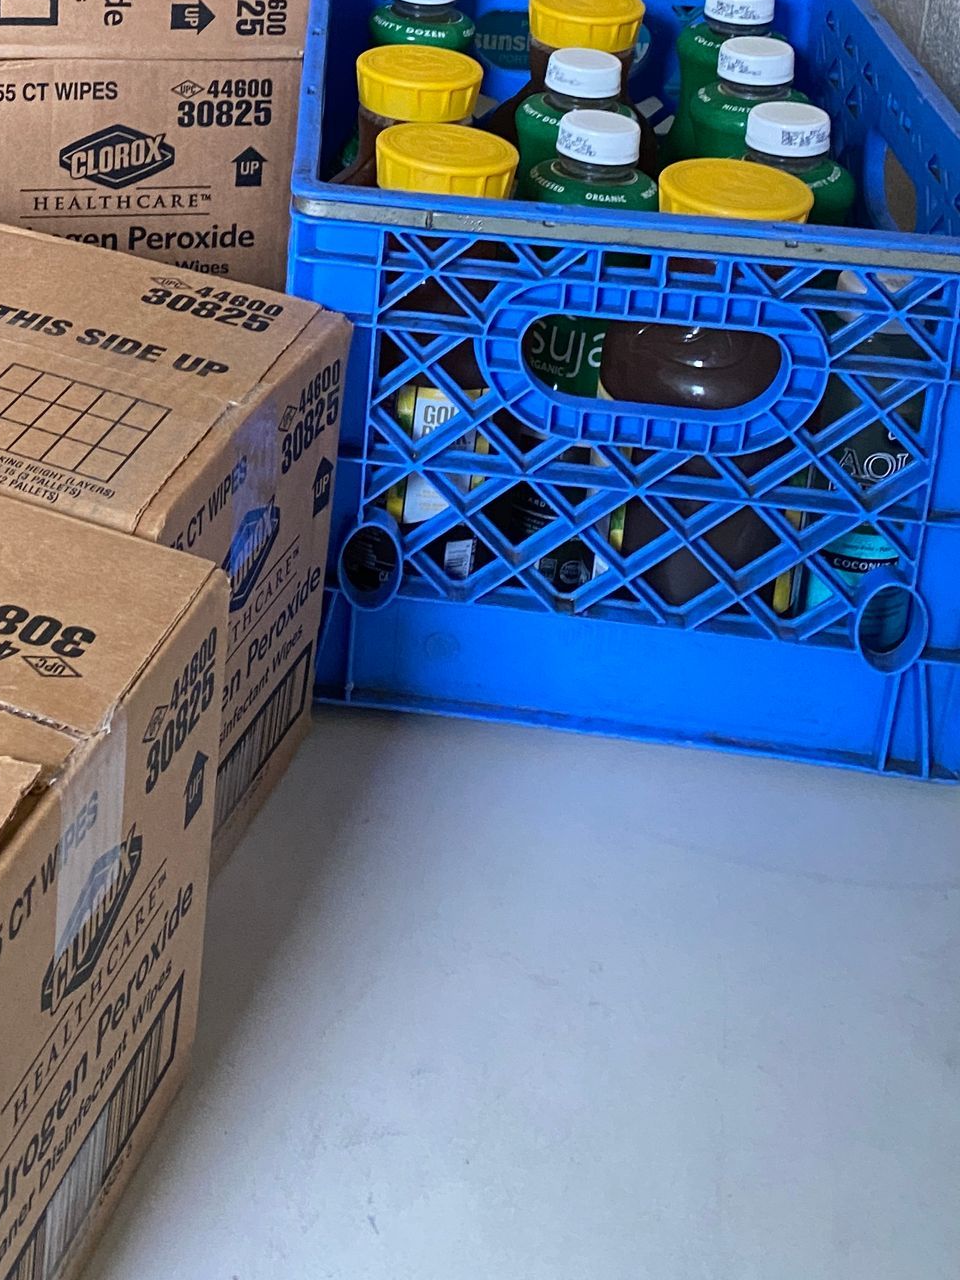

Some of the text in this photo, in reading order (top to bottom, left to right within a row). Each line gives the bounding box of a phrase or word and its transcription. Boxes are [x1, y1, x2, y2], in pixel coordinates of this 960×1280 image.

[183, 7, 200, 26] UP
[23, 81, 50, 102] CT
[55, 80, 119, 101] WIPES
[207, 78, 273, 99] 44600
[177, 99, 272, 127] 30825
[69, 131, 167, 180] CLOROX
[240, 160, 259, 175] UP
[585, 192, 627, 203] ORGANIC
[128, 224, 255, 251] Peroxide
[140, 288, 276, 333] 30825
[194, 286, 285, 317] 44600
[76, 328, 168, 363] SIDE
[172, 353, 230, 377] UP
[299, 359, 340, 414] 44600
[281, 385, 339, 475] 30825
[8, 479, 60, 504] PALLETS)
[27, 463, 65, 480] HEIGHT
[65, 476, 116, 499] (LAYERS)
[29, 473, 82, 498] PALLETS)
[314, 474, 330, 498] UP
[187, 455, 248, 550] CT WIPES
[246, 565, 321, 671] Peroxide
[35, 659, 66, 675] UPC
[271, 623, 303, 675] Wipes
[171, 626, 217, 710] 44600
[145, 658, 215, 795] 30825
[187, 778, 204, 803] UP
[8, 874, 38, 941] CT
[40, 789, 100, 896] WIPES
[95, 881, 194, 1061] Peroxide
[38, 959, 173, 1194] Disinfectant Wipes
